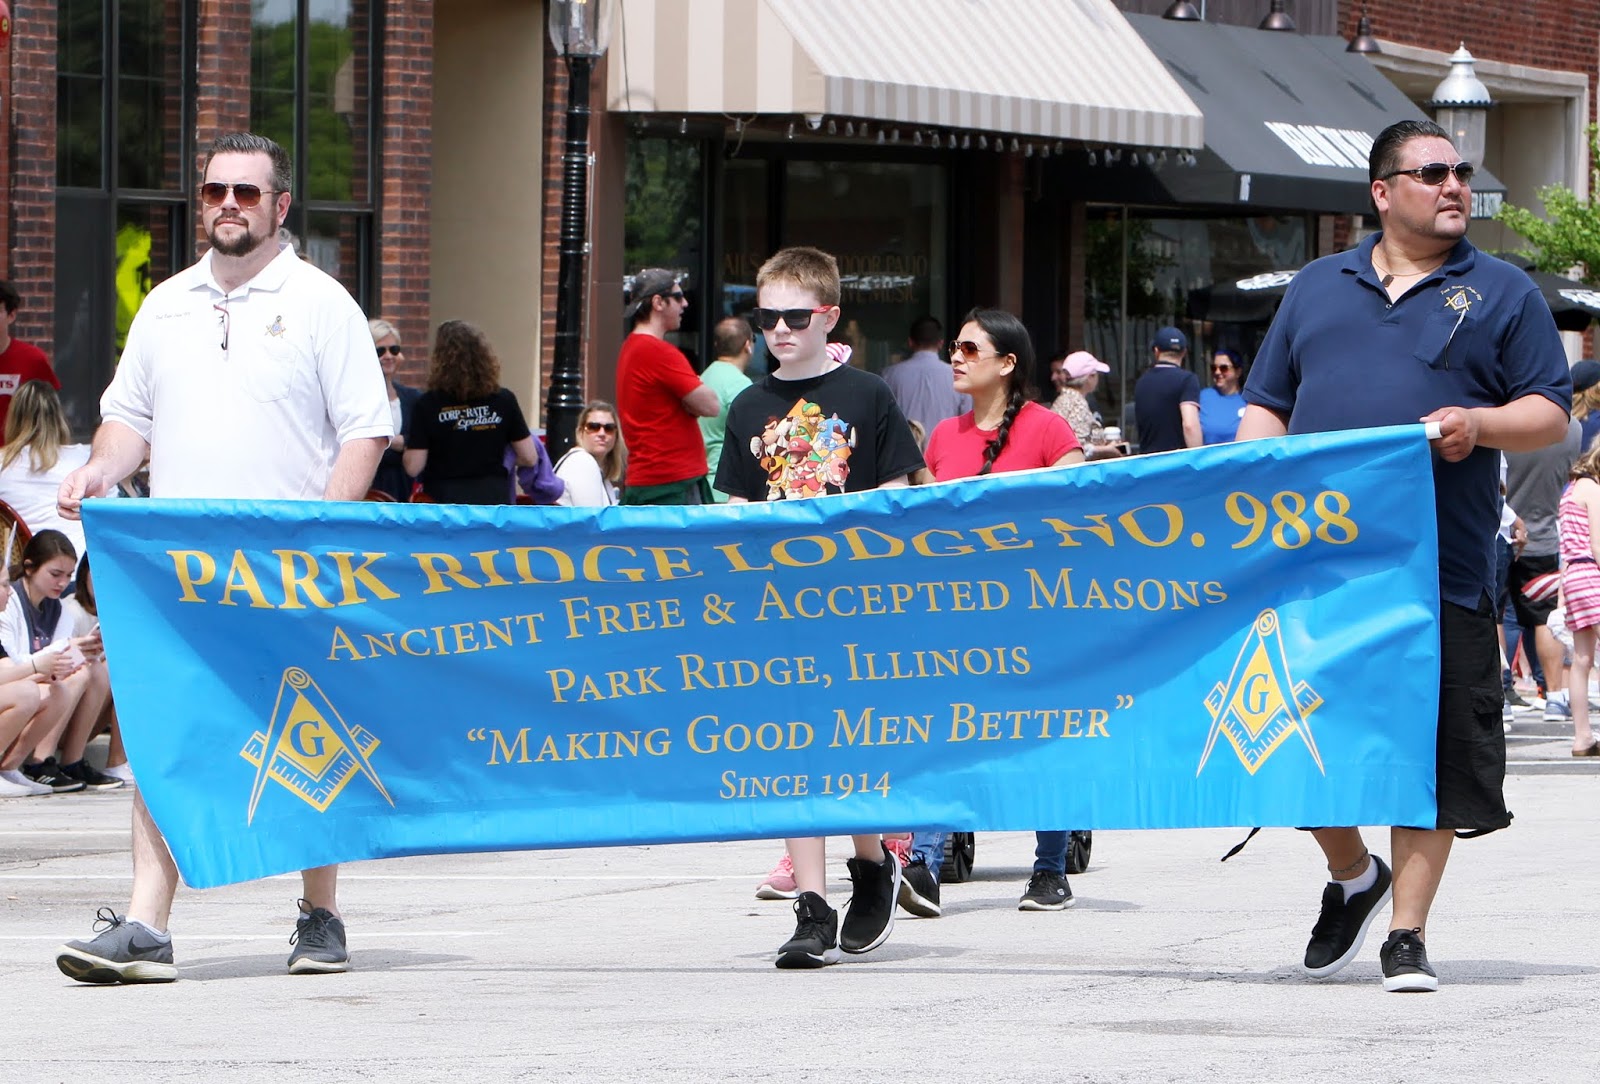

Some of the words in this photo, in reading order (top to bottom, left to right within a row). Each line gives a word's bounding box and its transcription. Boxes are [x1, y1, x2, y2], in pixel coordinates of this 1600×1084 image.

[167, 549, 400, 609] PARK
[416, 544, 705, 595] RIDGE
[713, 522, 1035, 572] LODGE
[1042, 503, 1206, 548] NO.
[1225, 490, 1359, 550] 988
[327, 613, 544, 661] ANCIENT
[560, 596, 685, 639] FREE
[702, 593, 737, 625] &
[754, 579, 1010, 621] ACCEPTED
[1025, 567, 1228, 611] MASONS
[547, 668, 666, 704] PARK
[680, 653, 833, 690] RIDGE,
[843, 643, 1031, 681] ILLINOIS
[1243, 673, 1271, 714] G
[289, 720, 325, 759] G
[687, 715, 814, 754] GOOD
[828, 707, 934, 748] MEN
[719, 769, 809, 799] SINCE
[820, 770, 892, 801] 1914
